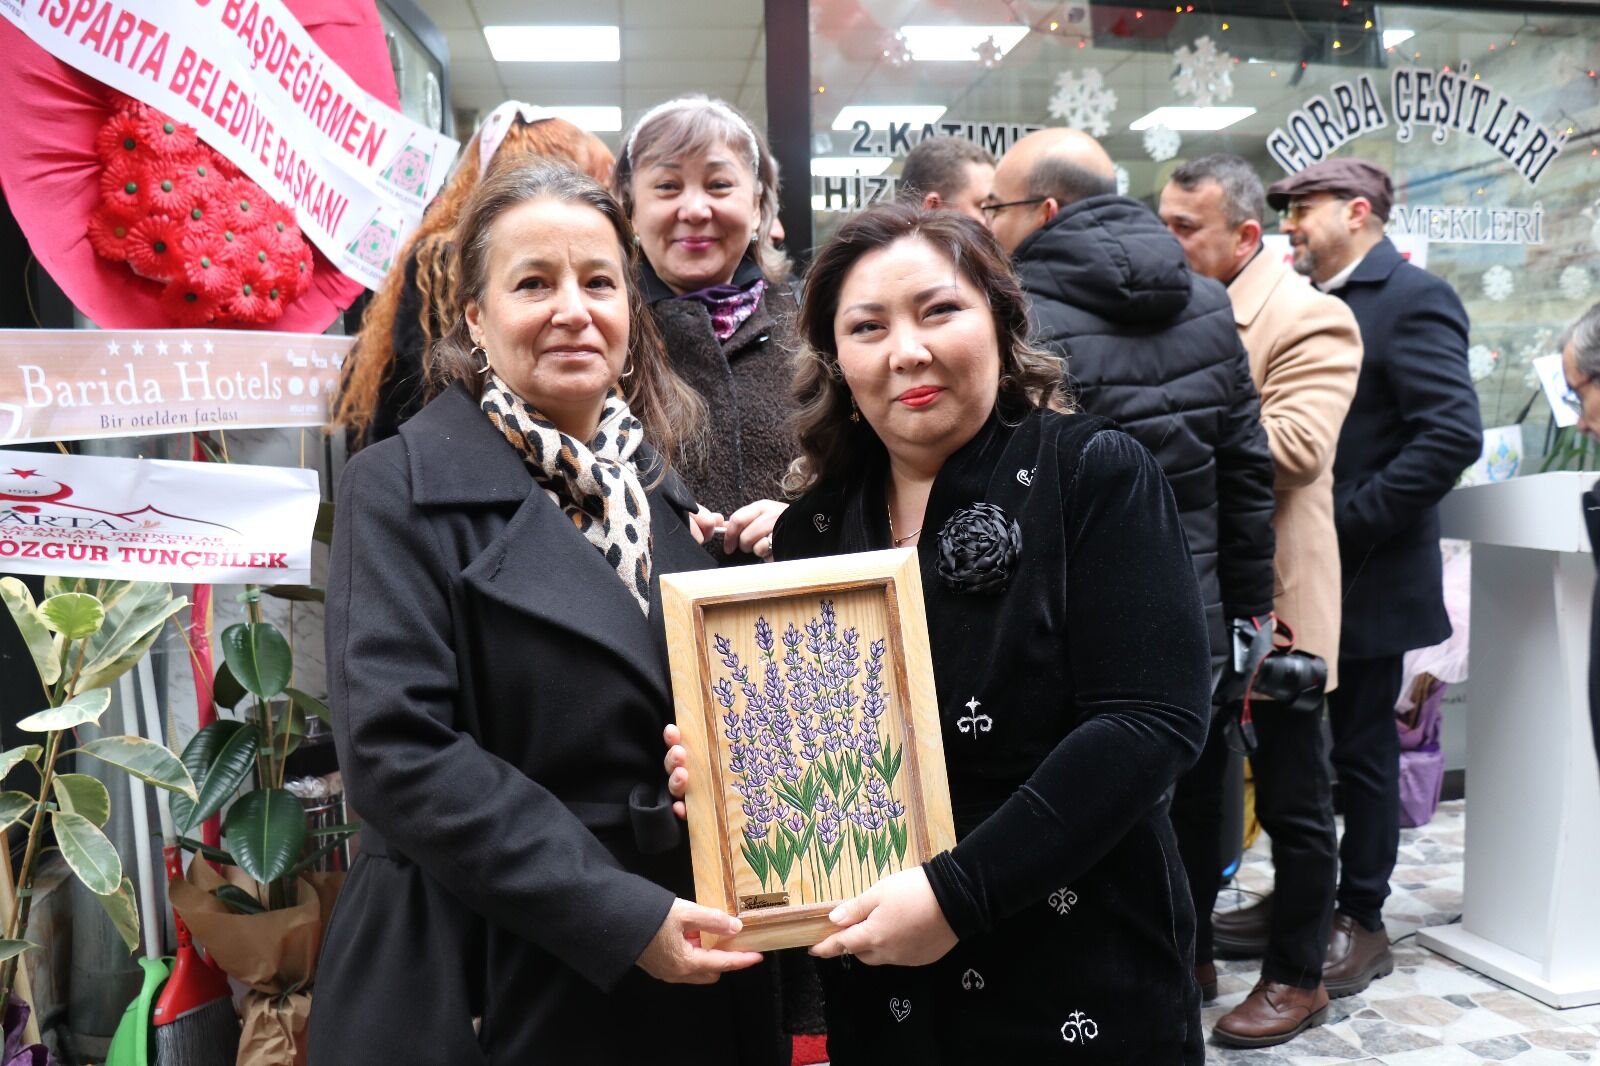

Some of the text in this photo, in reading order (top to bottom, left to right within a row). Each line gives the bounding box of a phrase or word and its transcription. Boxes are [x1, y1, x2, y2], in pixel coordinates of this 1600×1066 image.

[168, 46, 272, 167] BELEDİYE
[273, 133, 350, 240] BAŞKANI
[17, 360, 282, 409] Barida Hotels
[100, 414, 125, 429] Bir
[131, 410, 188, 427] otelden
[0, 535, 288, 570] ÖZGÜR TUNÇBİLEK
